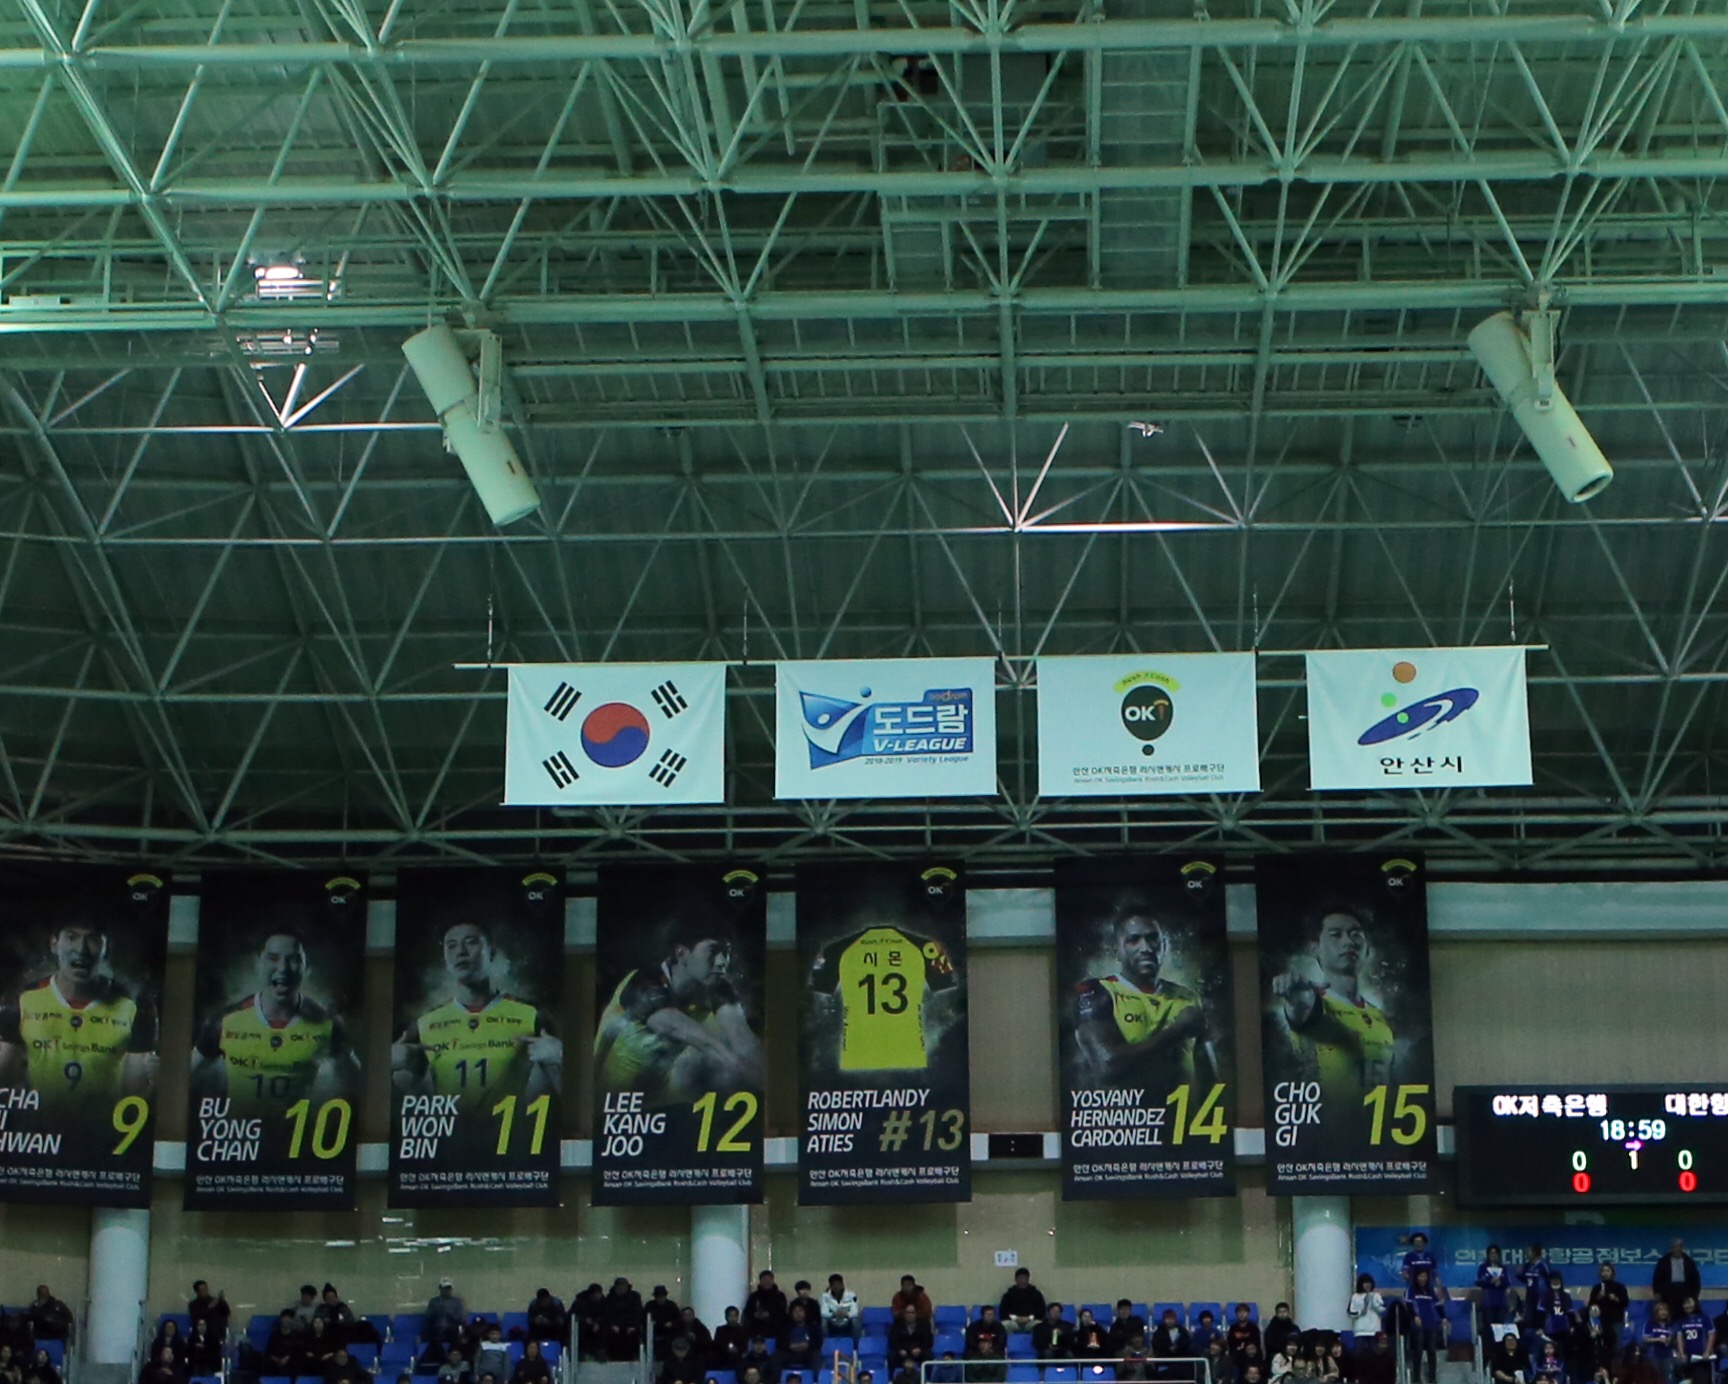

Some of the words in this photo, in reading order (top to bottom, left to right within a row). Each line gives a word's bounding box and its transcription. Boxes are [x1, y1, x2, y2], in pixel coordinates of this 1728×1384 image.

[872, 704, 969, 736] 도드람
[873, 736, 967, 752] V-LEAGUE
[907, 755, 937, 766] Variety
[939, 754, 969, 765] League
[1379, 754, 1464, 776] 안산시
[858, 973, 909, 1015] 13
[603, 1092, 644, 1113] LEE
[807, 1089, 931, 1110] ROBERTLANDY
[1071, 1088, 1145, 1107] YOSVANY
[1273, 1081, 1321, 1103] CHO
[199, 1097, 231, 1117] BU
[401, 1094, 461, 1116] PARK
[1165, 1083, 1228, 1145] 14
[1274, 1103, 1322, 1125] GUK
[1362, 1083, 1430, 1147] 15
[1491, 1093, 1609, 1118] OK저축은행
[111, 1096, 151, 1156] 9
[401, 1117, 455, 1138] WON
[491, 1094, 551, 1156] 11
[603, 1114, 666, 1135] KANG
[691, 1091, 759, 1153] 12
[807, 1111, 863, 1132] SIMON
[1071, 1108, 1165, 1127] HERNANDEZ
[199, 1118, 262, 1140] YONG
[285, 1098, 353, 1159] 10
[1070, 1128, 1163, 1148] CARDONELL
[1275, 1126, 1299, 1148] GI
[1599, 1119, 1666, 1141] 18:59
[196, 1140, 259, 1162] CHAN
[399, 1138, 438, 1159] BIN
[601, 1135, 643, 1157] JOO
[806, 1133, 854, 1154] ATIES
[1572, 1151, 1586, 1171] 0
[1629, 1150, 1639, 1170] 1
[1678, 1149, 1693, 1170] 0
[1573, 1172, 1590, 1192] 0
[1679, 1171, 1696, 1191] 0
